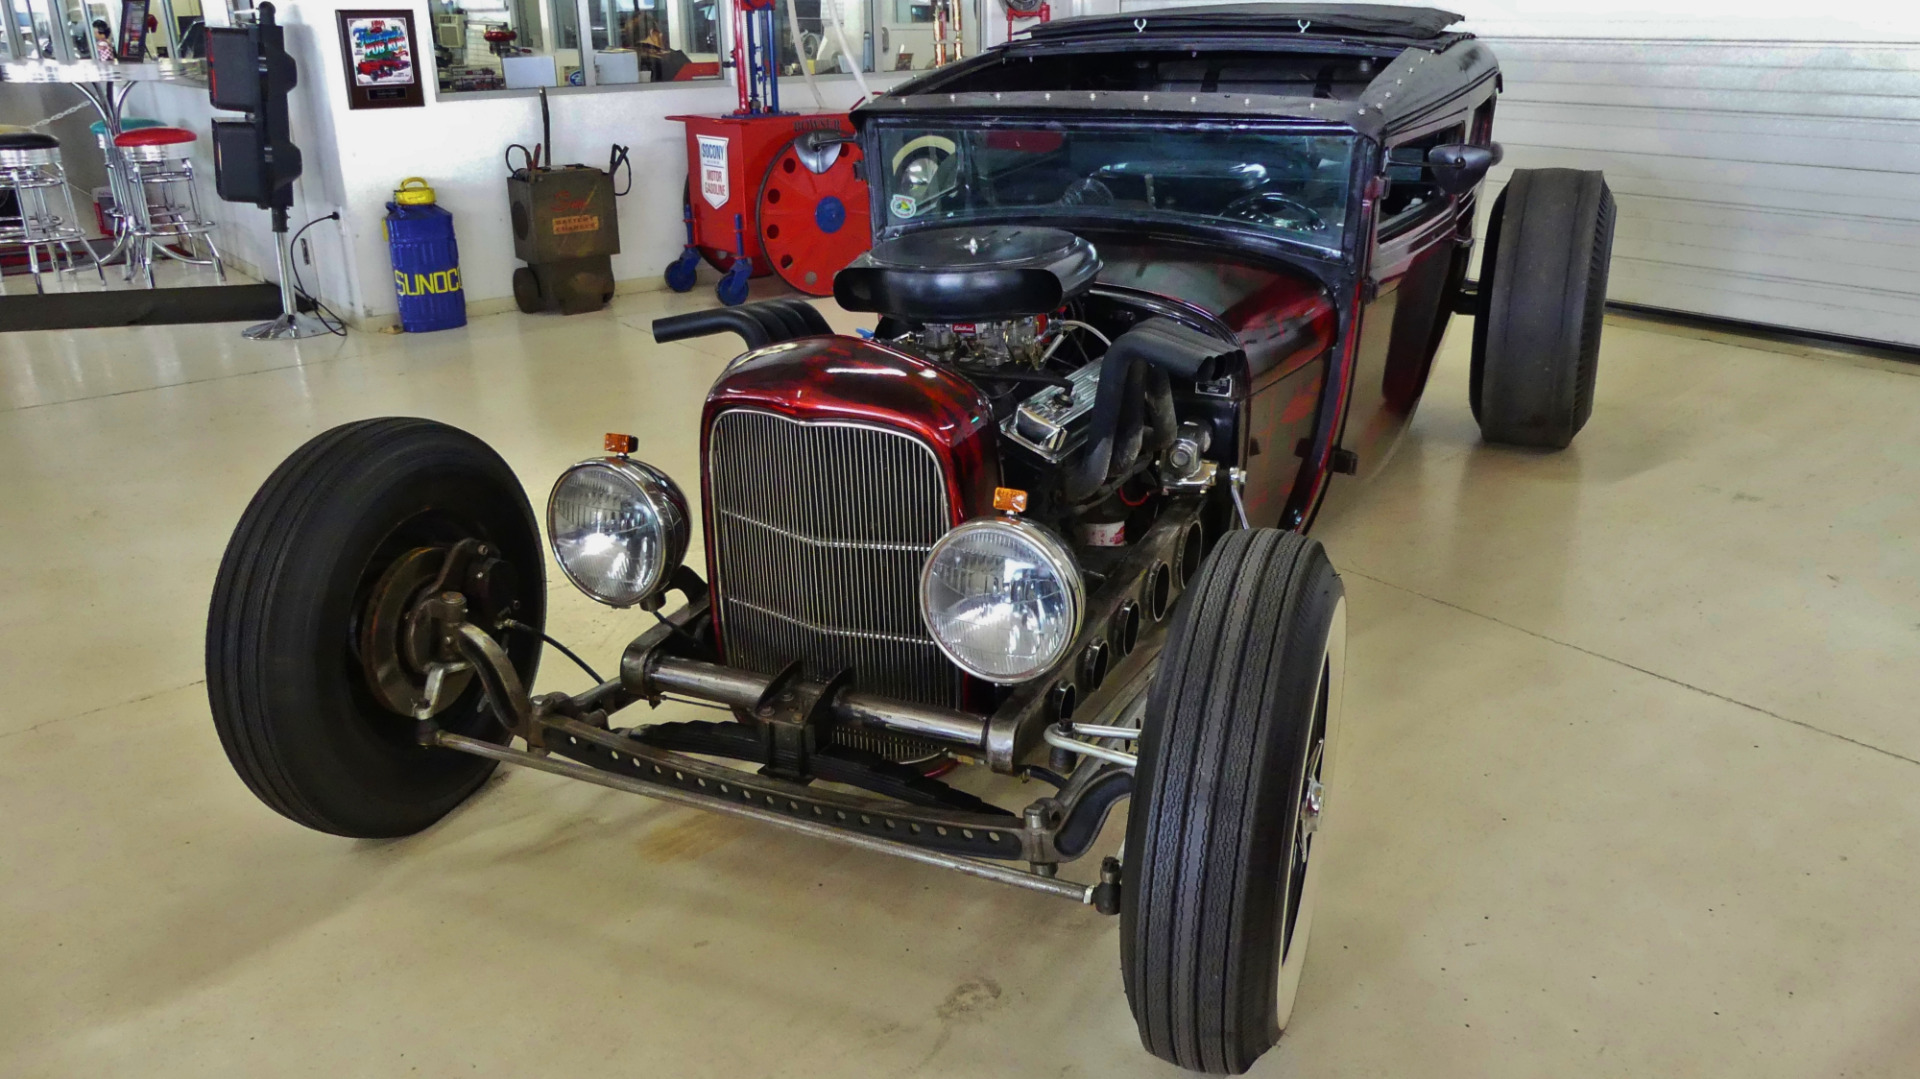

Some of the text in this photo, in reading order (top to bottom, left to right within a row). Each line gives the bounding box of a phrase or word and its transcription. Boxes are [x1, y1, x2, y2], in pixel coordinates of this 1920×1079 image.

[702, 143, 725, 160] SOCONY
[706, 169, 722, 182] MOTOR
[704, 182, 726, 196] GASOLINE
[395, 268, 462, 296] SUNOC
